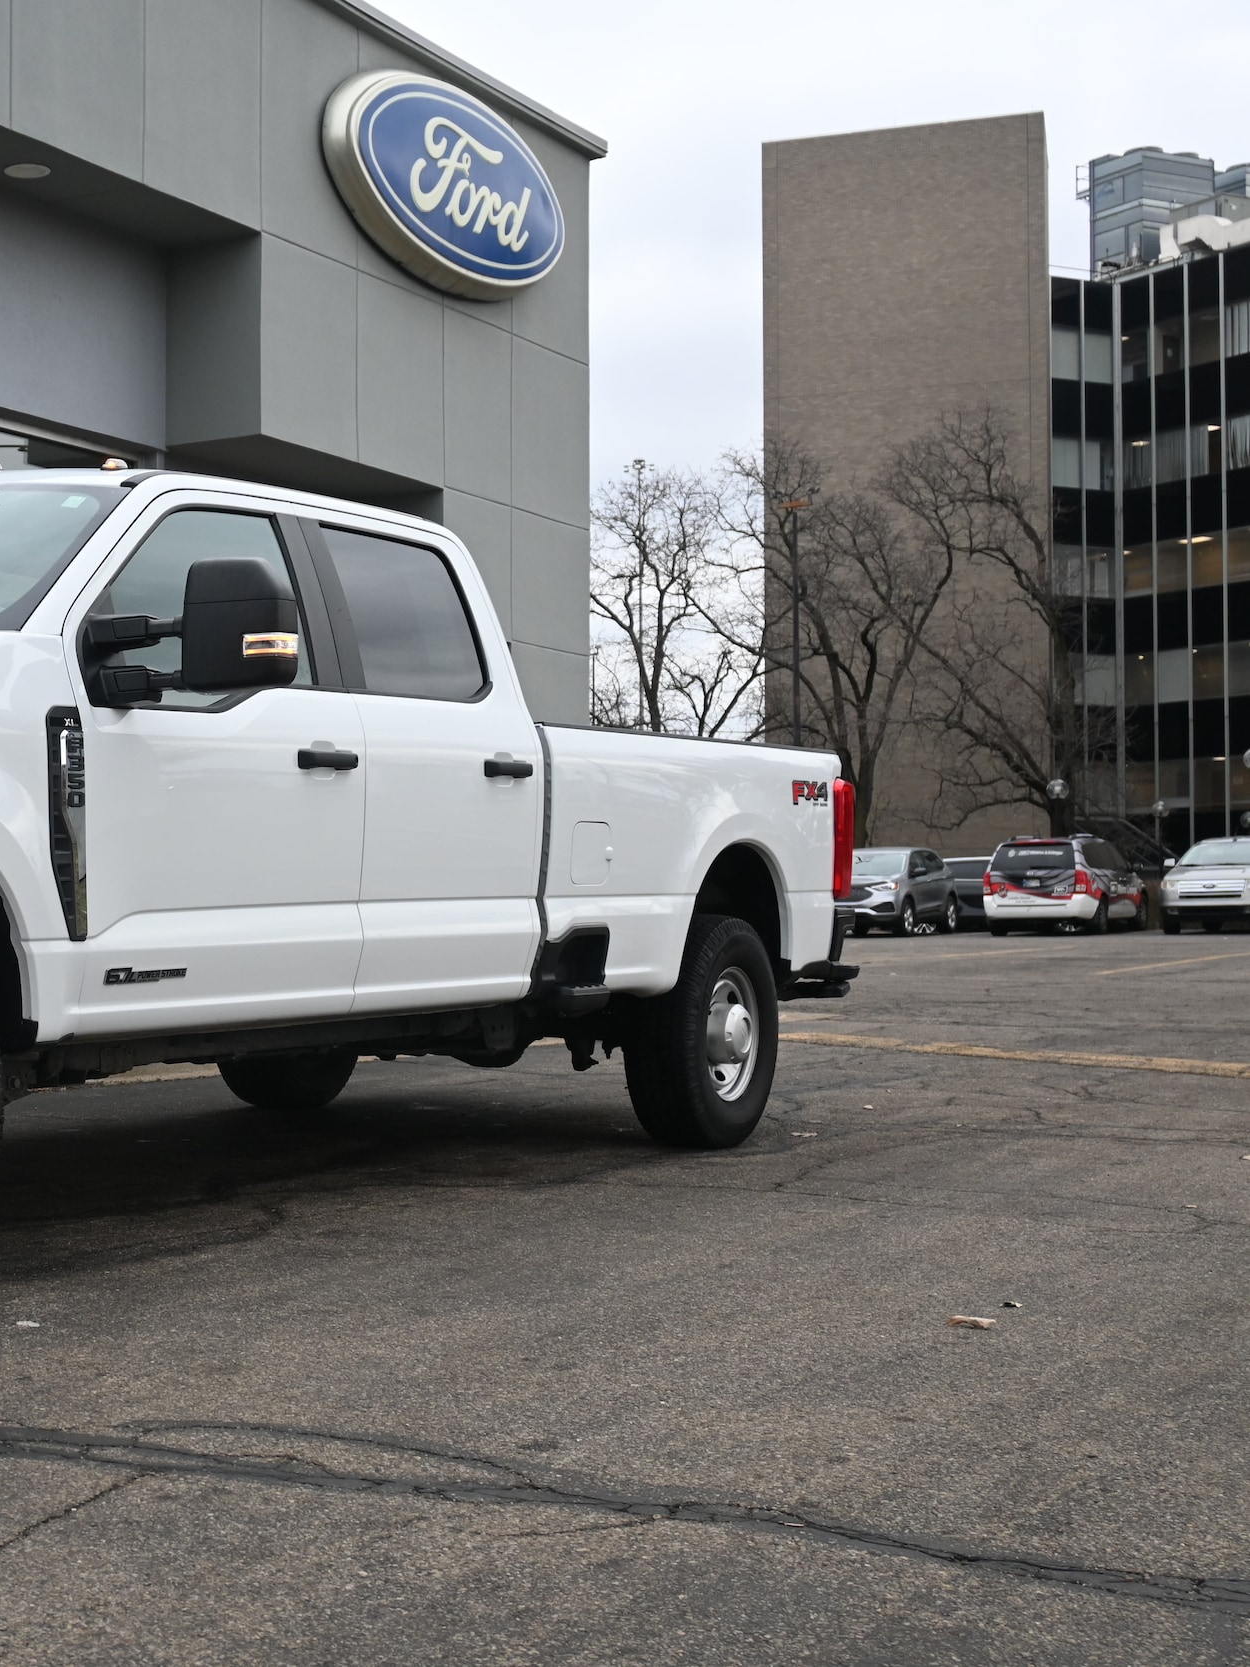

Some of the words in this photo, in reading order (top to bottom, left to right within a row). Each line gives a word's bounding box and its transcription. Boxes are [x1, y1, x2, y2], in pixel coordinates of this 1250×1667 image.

[410, 116, 532, 252] Ford
[792, 779, 828, 806] FX4
[103, 966, 137, 985] 6.7L
